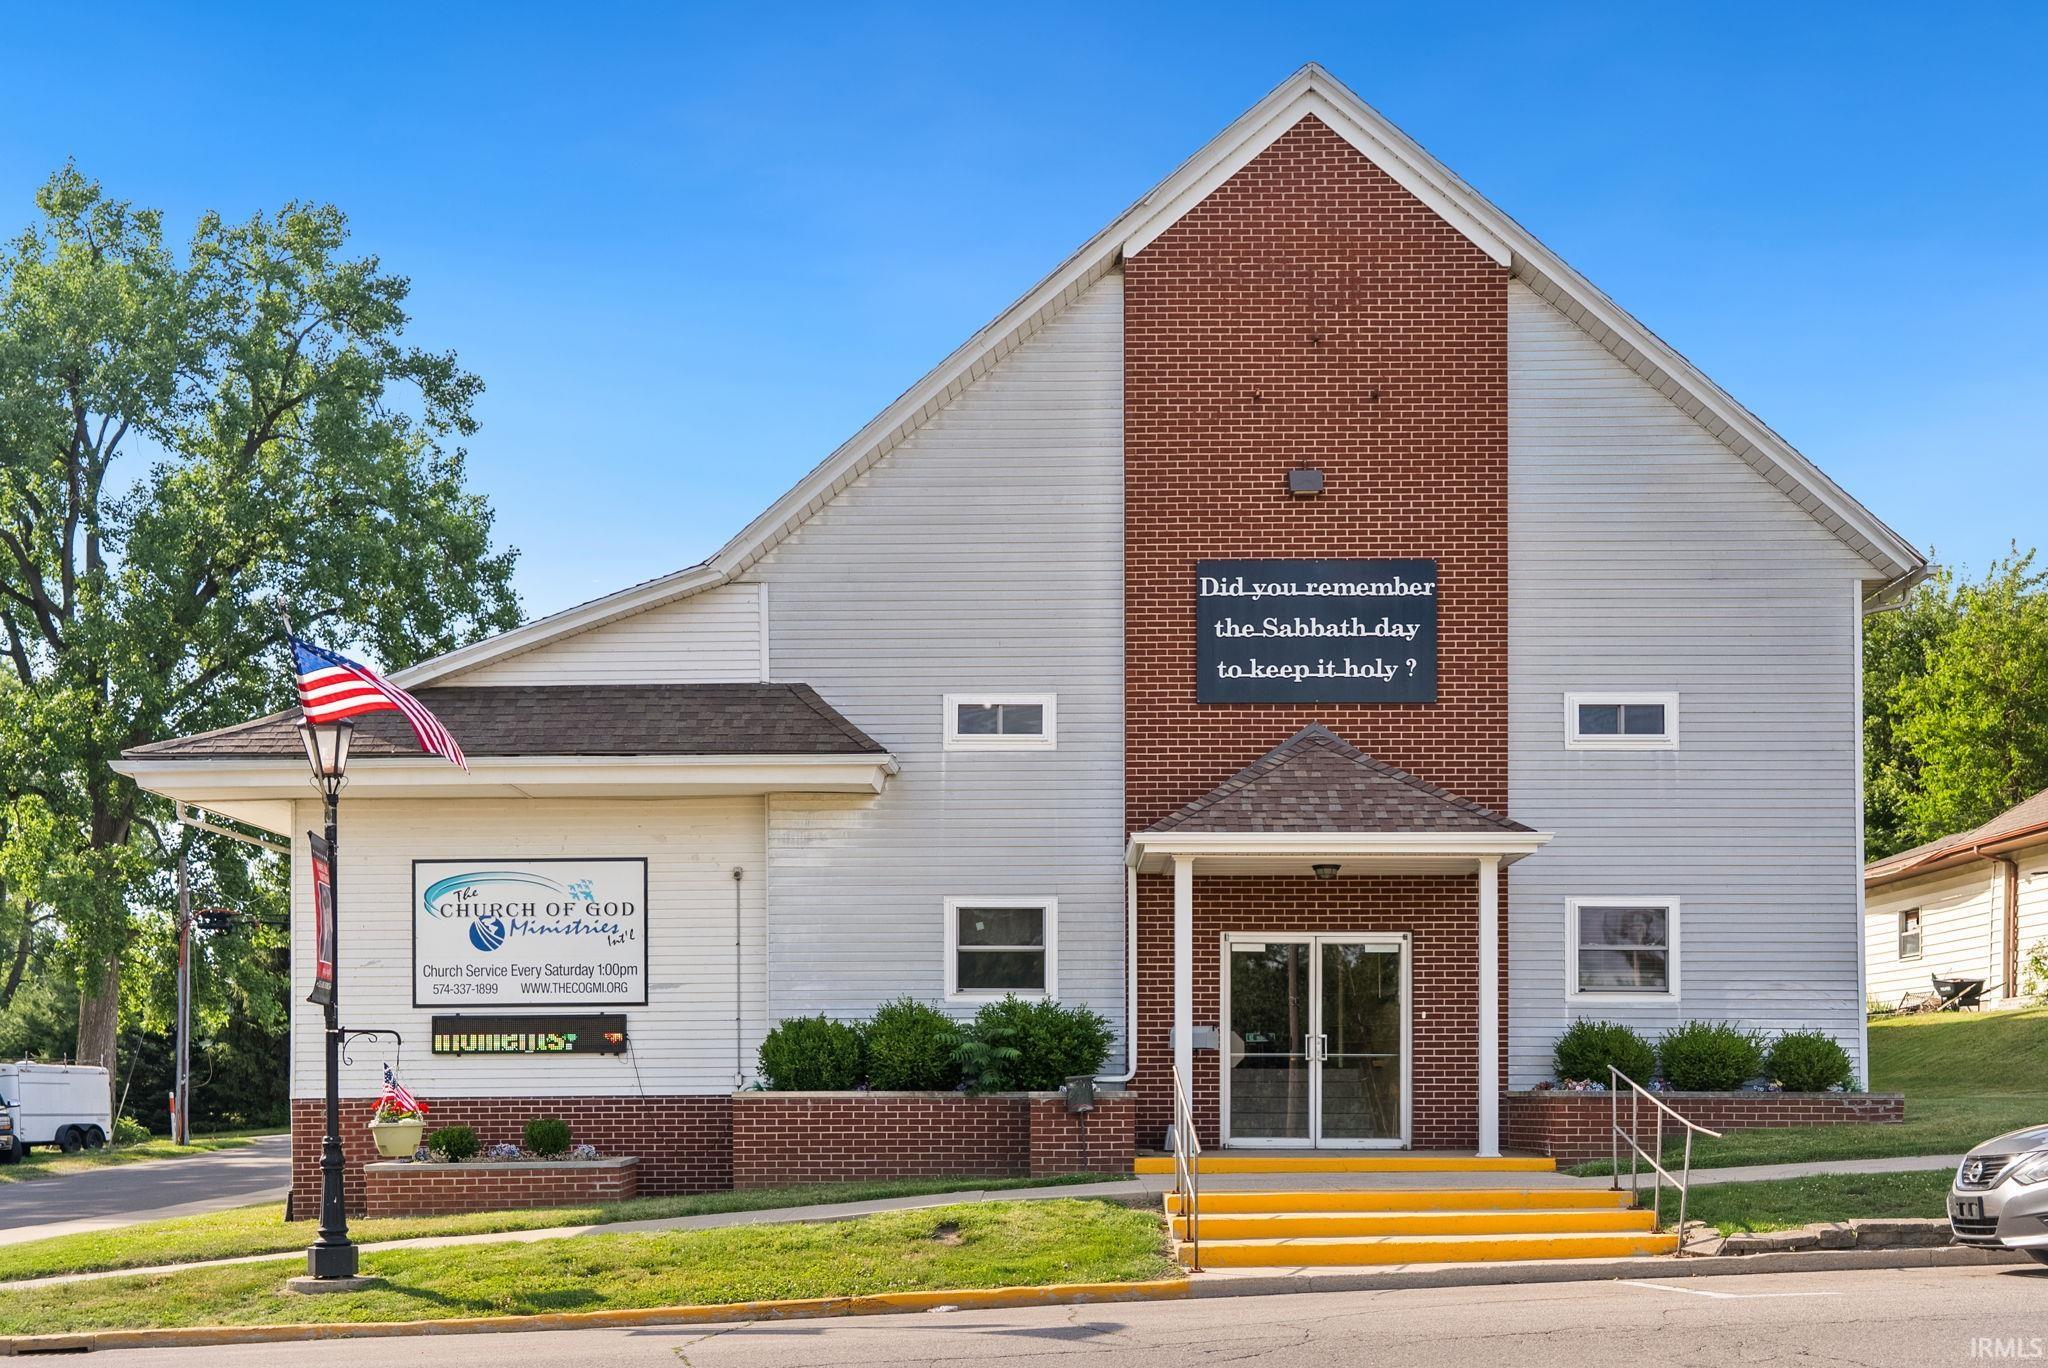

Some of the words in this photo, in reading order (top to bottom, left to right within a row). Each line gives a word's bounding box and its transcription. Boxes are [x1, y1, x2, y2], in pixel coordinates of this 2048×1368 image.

[1199, 576, 1243, 597] Did
[1251, 581, 1298, 601] you
[1306, 576, 1436, 597] remember
[1214, 617, 1255, 638] the
[1262, 617, 1367, 638] Sabbath
[1374, 617, 1421, 641] day
[1217, 660, 1243, 679] to
[1249, 658, 1310, 683] keep
[1316, 658, 1336, 679] it
[1343, 658, 1399, 682] holy
[1405, 658, 1418, 677] ?
[453, 886, 479, 903] The
[440, 902, 535, 918] CHURCH
[546, 902, 576, 917] OF
[585, 901, 635, 917] GOD
[509, 918, 620, 937] Ministries
[607, 928, 636, 947] Int'l
[423, 964, 463, 978] Church
[466, 964, 508, 978] Service
[511, 964, 542, 980] Every
[544, 963, 595, 979] Saturday
[597, 963, 638, 979] 1:00pm
[432, 983, 499, 995] 574-337-1899
[520, 982, 628, 994] WWW.THECOGMI.ORG
